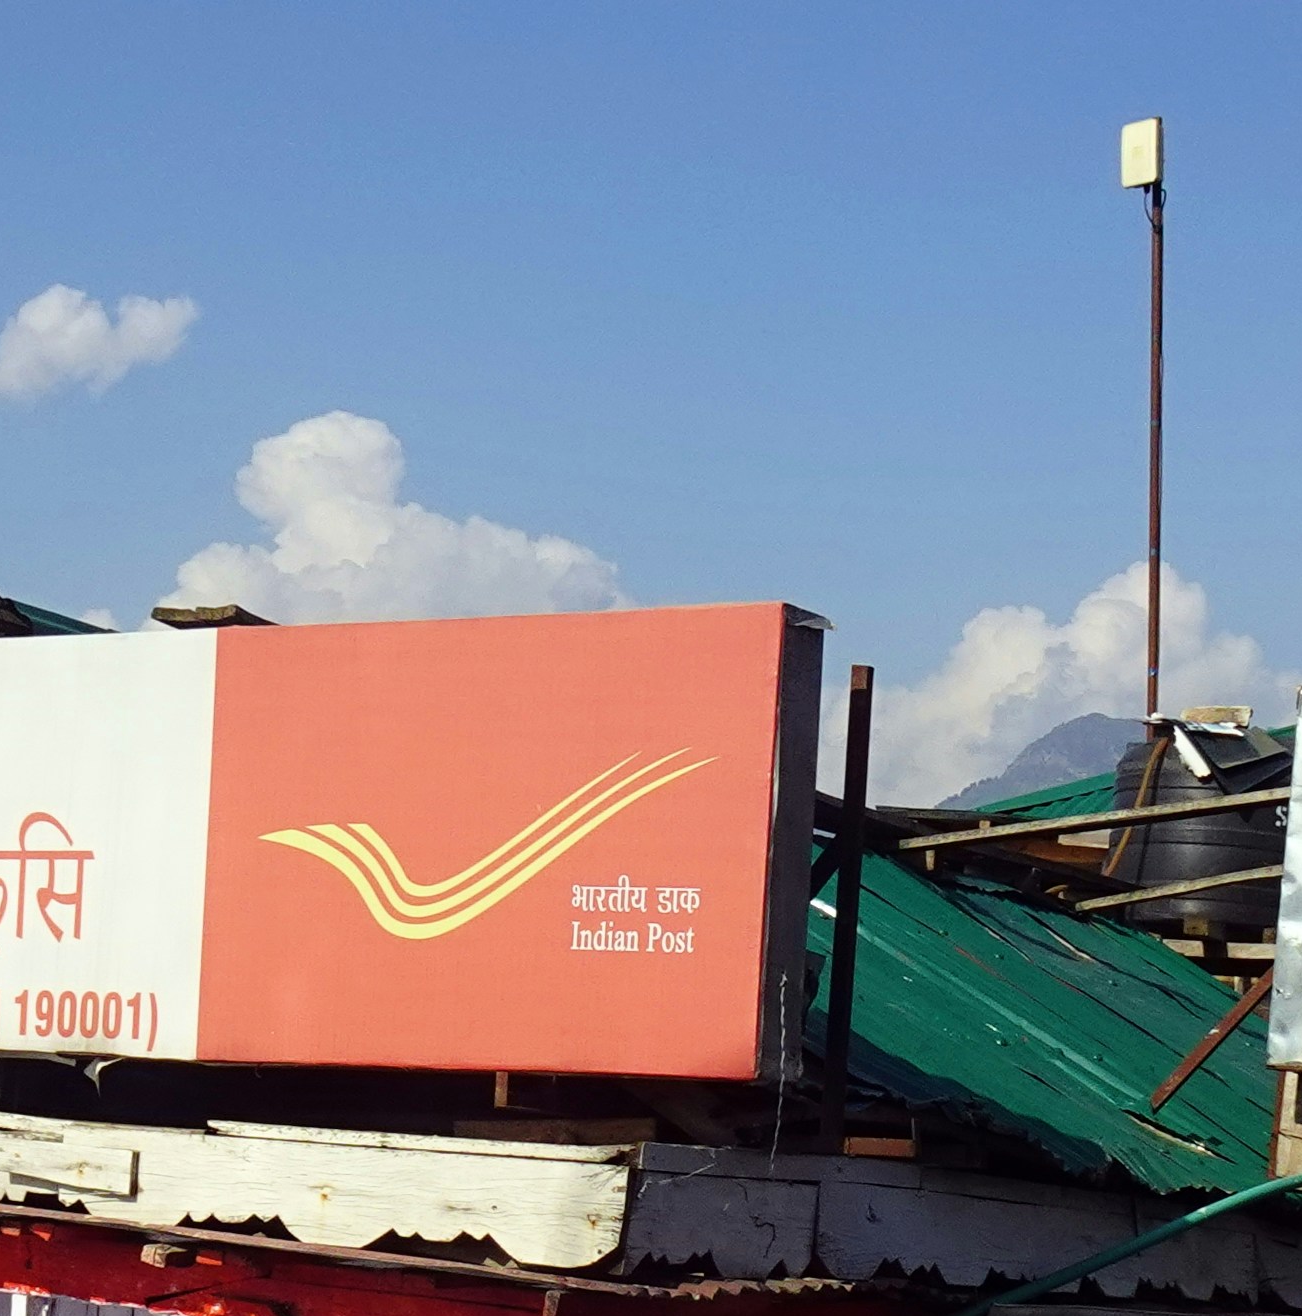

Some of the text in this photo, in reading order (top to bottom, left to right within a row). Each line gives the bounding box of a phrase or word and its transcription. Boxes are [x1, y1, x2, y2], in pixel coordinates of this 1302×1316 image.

[571, 874, 701, 915] भारतीय डाक
[570, 920, 695, 954] Indian Post
[13, 989, 160, 1054] 190001)
